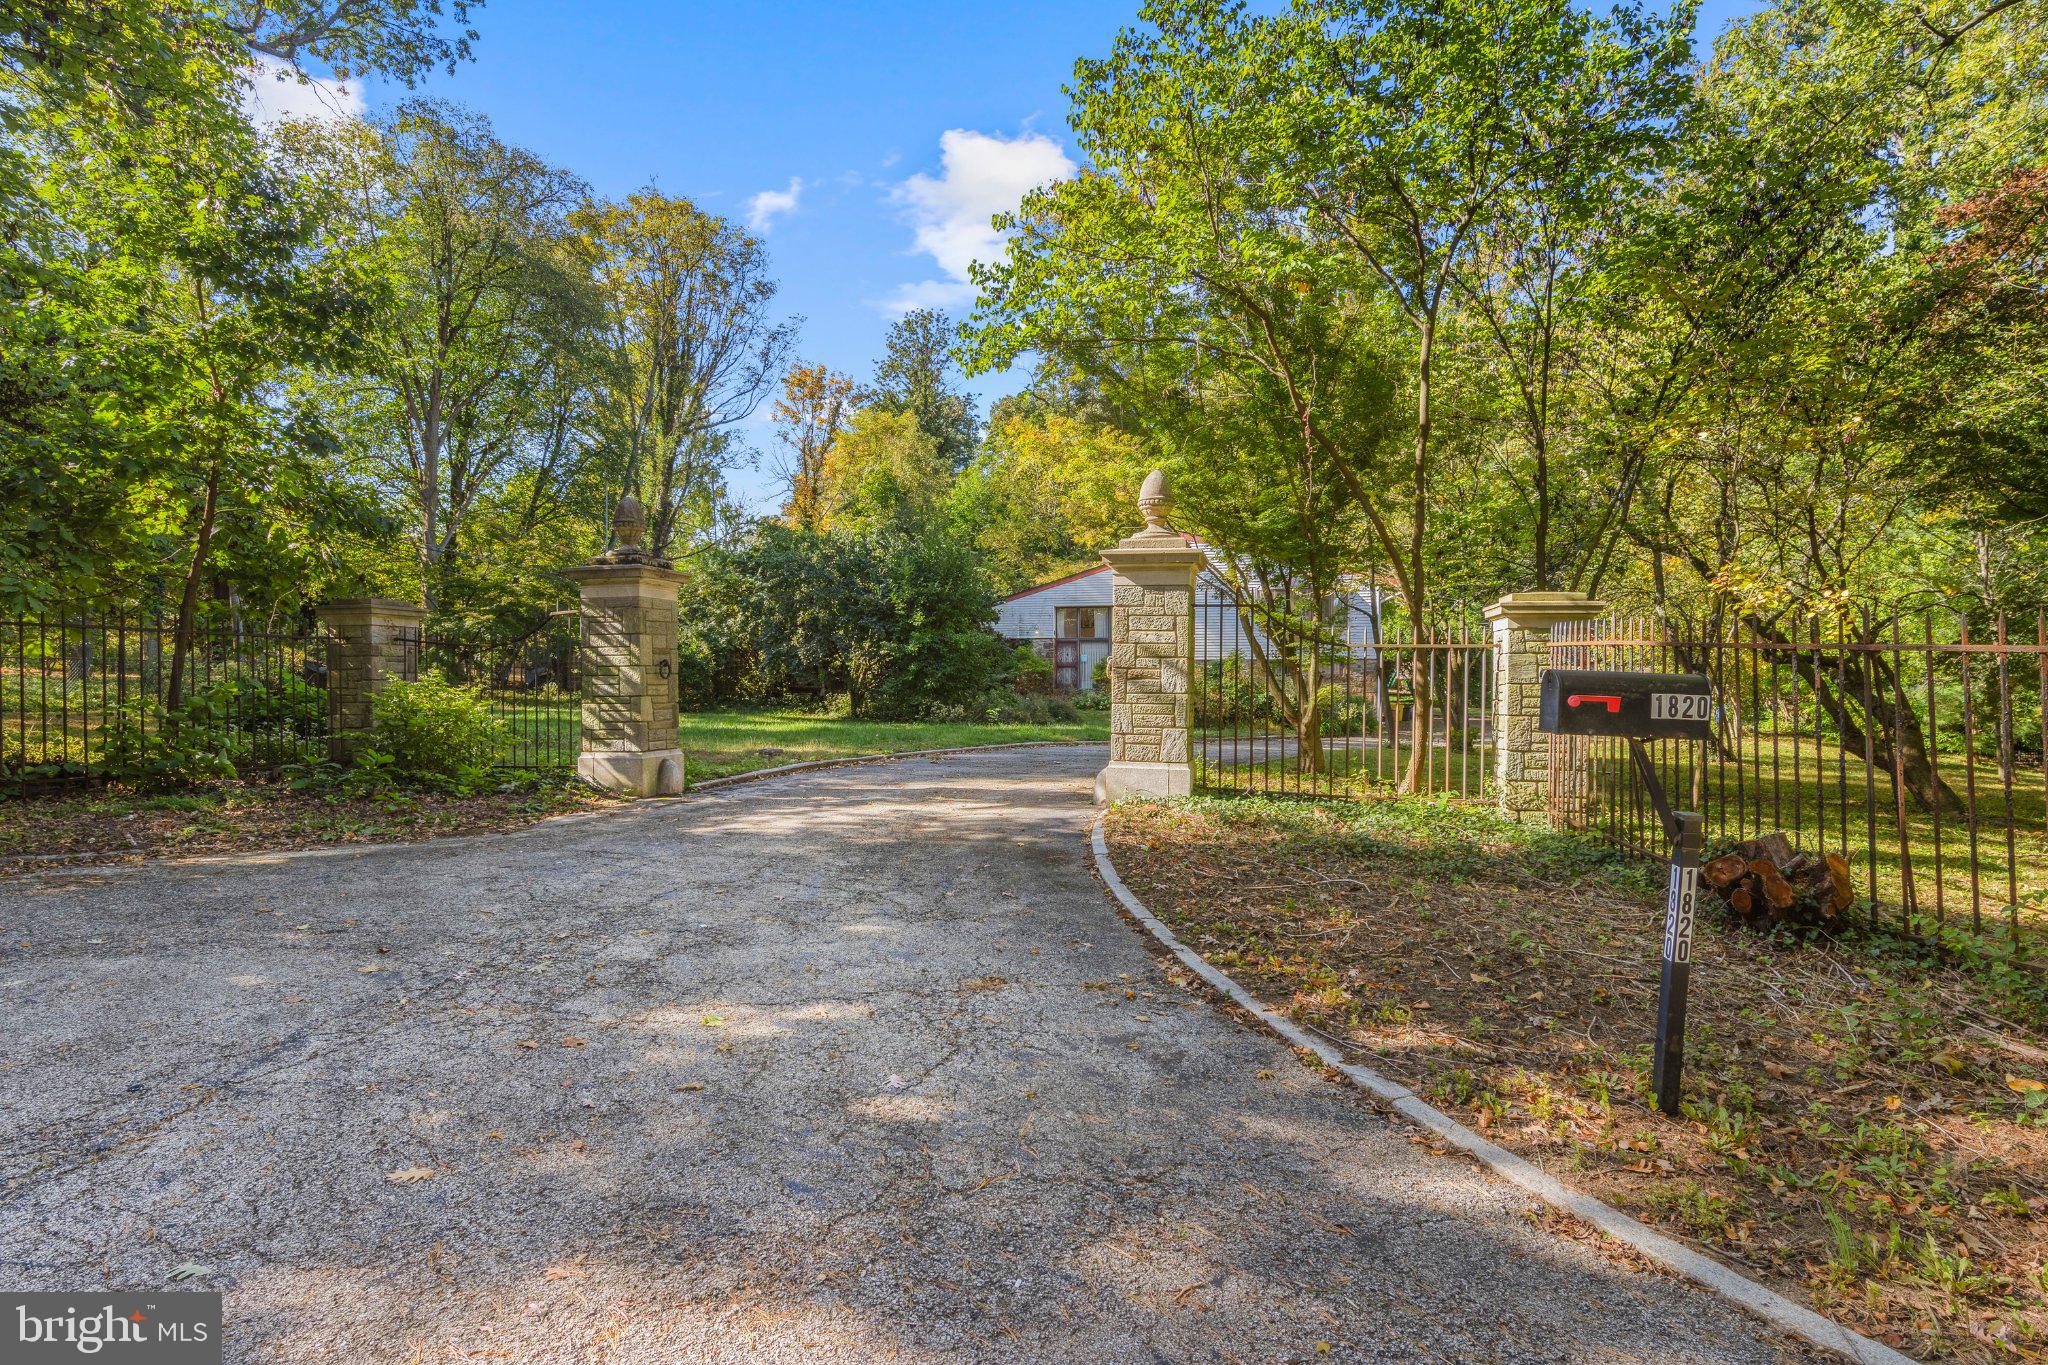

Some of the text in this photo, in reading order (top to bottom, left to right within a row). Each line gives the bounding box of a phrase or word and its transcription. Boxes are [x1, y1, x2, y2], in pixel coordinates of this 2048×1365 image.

[1655, 694, 1709, 719] 1820
[1665, 866, 1678, 959] 1820
[1678, 868, 1694, 962] 1820
